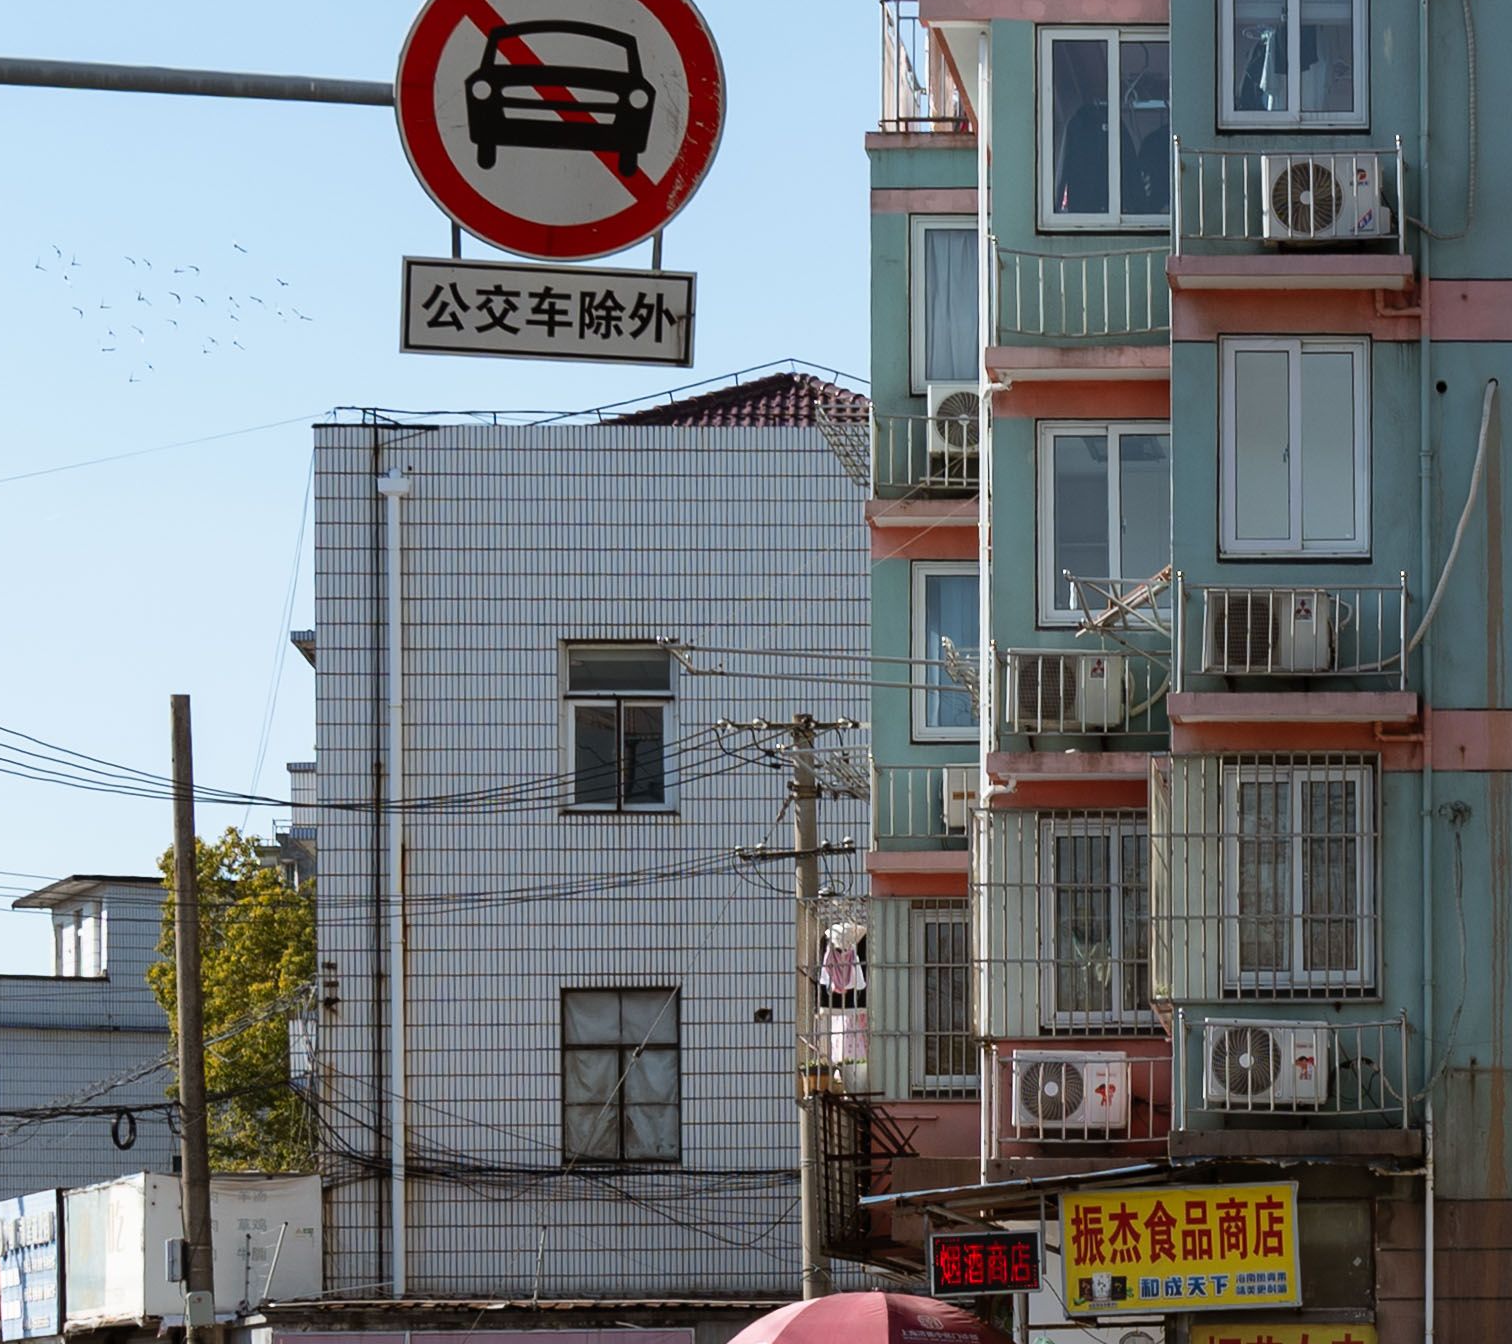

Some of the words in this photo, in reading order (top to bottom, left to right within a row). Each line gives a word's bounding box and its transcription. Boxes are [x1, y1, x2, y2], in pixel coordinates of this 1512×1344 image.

[421, 281, 677, 344] 公交车除外
[1070, 1194, 1285, 1267] 振杰食品商店
[939, 1240, 1031, 1286] 烟酒商店
[1140, 1274, 1230, 1299] 和成天下
